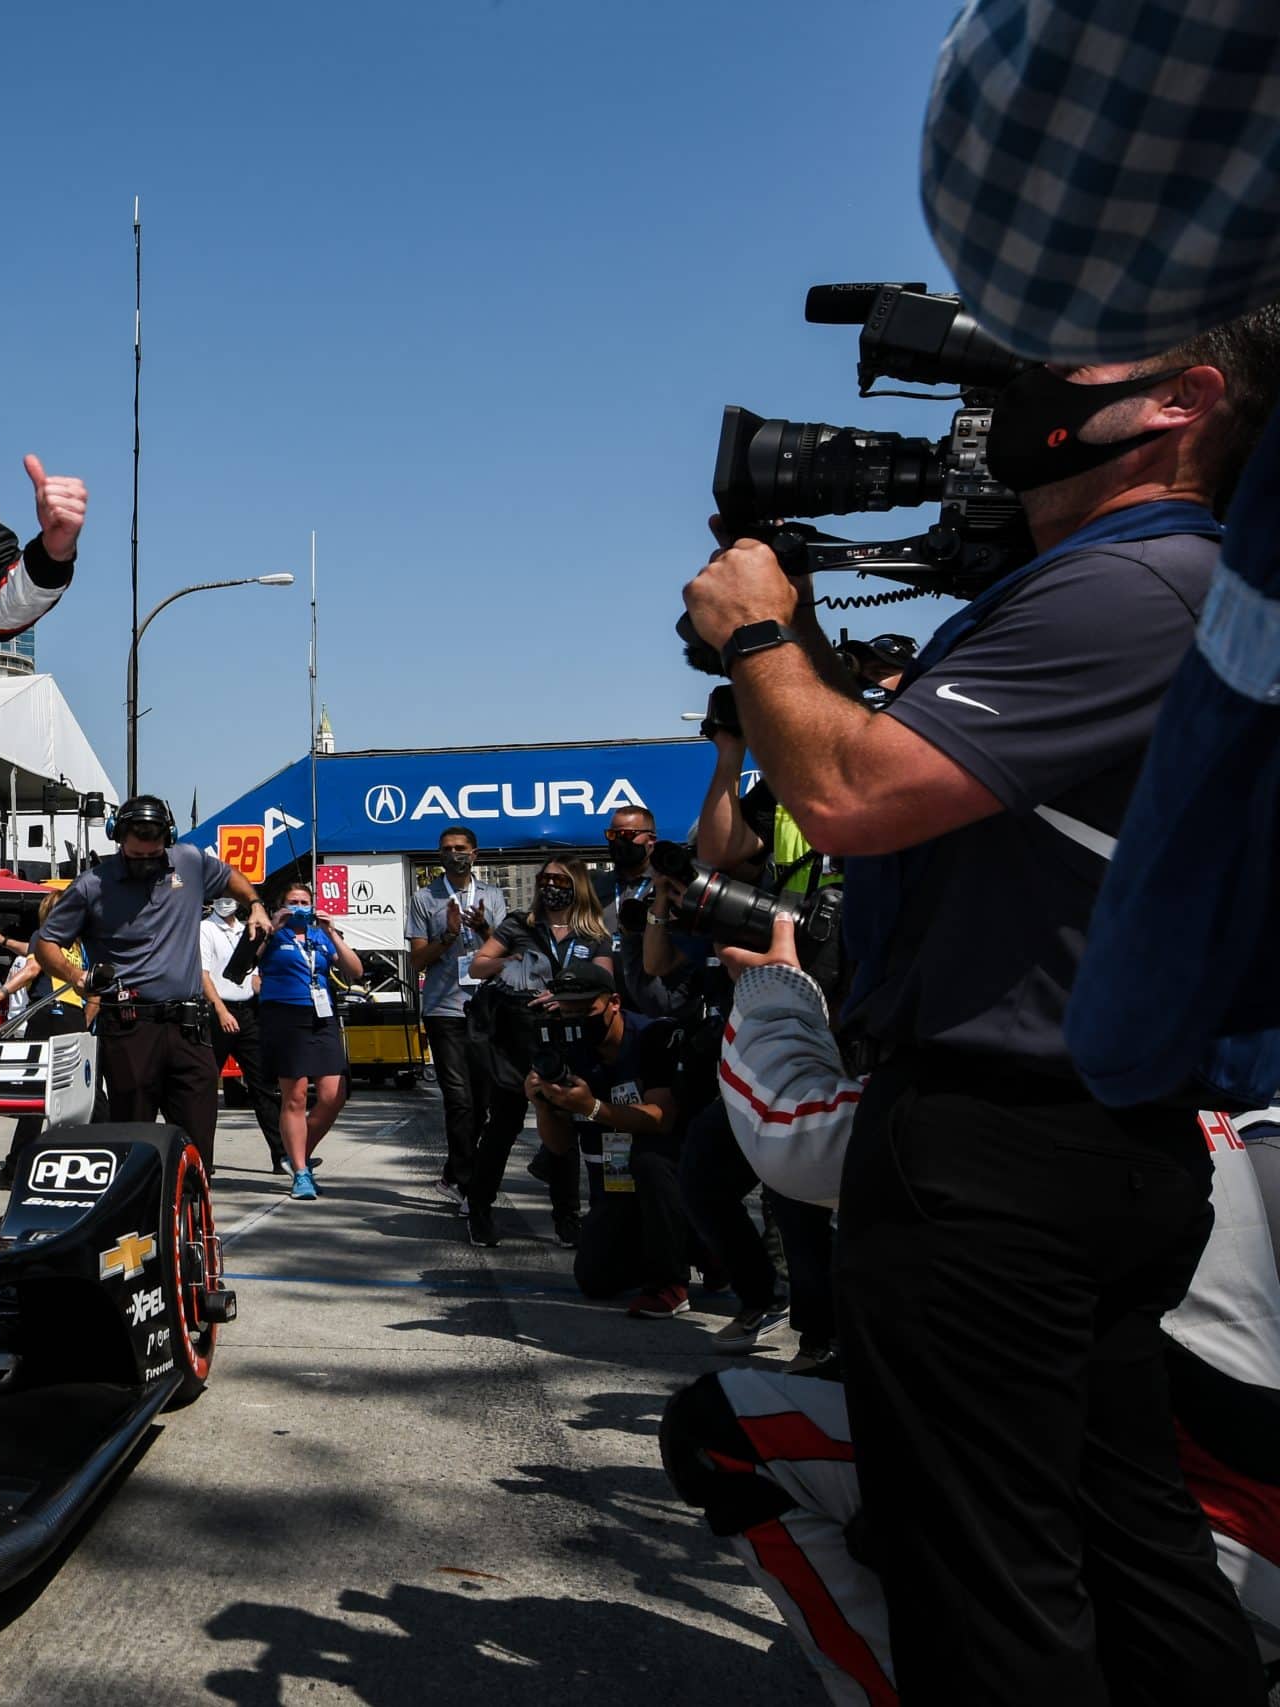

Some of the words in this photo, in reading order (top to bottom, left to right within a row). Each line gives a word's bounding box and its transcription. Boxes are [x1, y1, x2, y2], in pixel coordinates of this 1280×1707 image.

[410, 779, 650, 820] ACURA
[225, 837, 260, 873] 28
[322, 882, 340, 899] 60
[35, 1155, 111, 1188] PPG
[132, 1286, 166, 1327] XPEL
